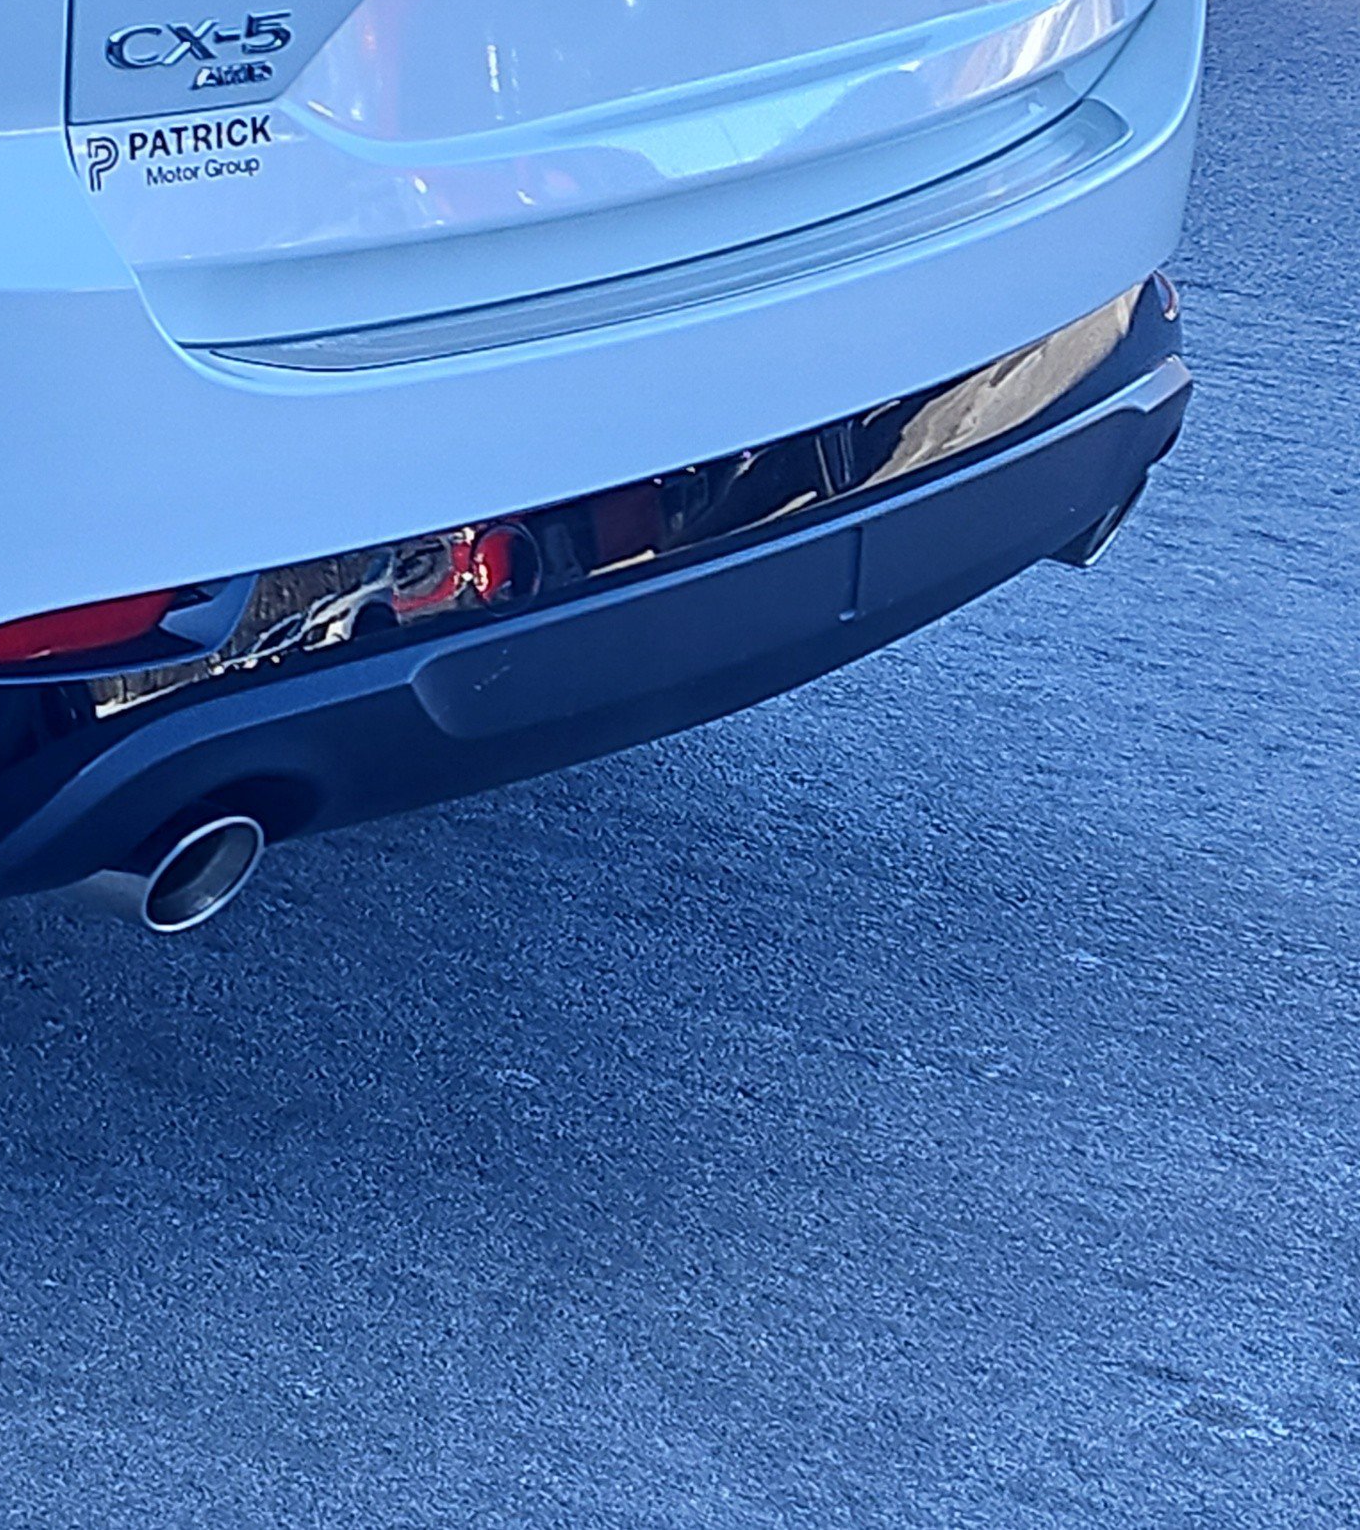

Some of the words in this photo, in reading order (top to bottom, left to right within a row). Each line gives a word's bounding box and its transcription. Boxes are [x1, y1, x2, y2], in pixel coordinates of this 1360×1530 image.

[106, 11, 291, 69] CX-5
[129, 115, 272, 160] PATRICK
[146, 164, 200, 186] Motor
[204, 157, 260, 176] Group
